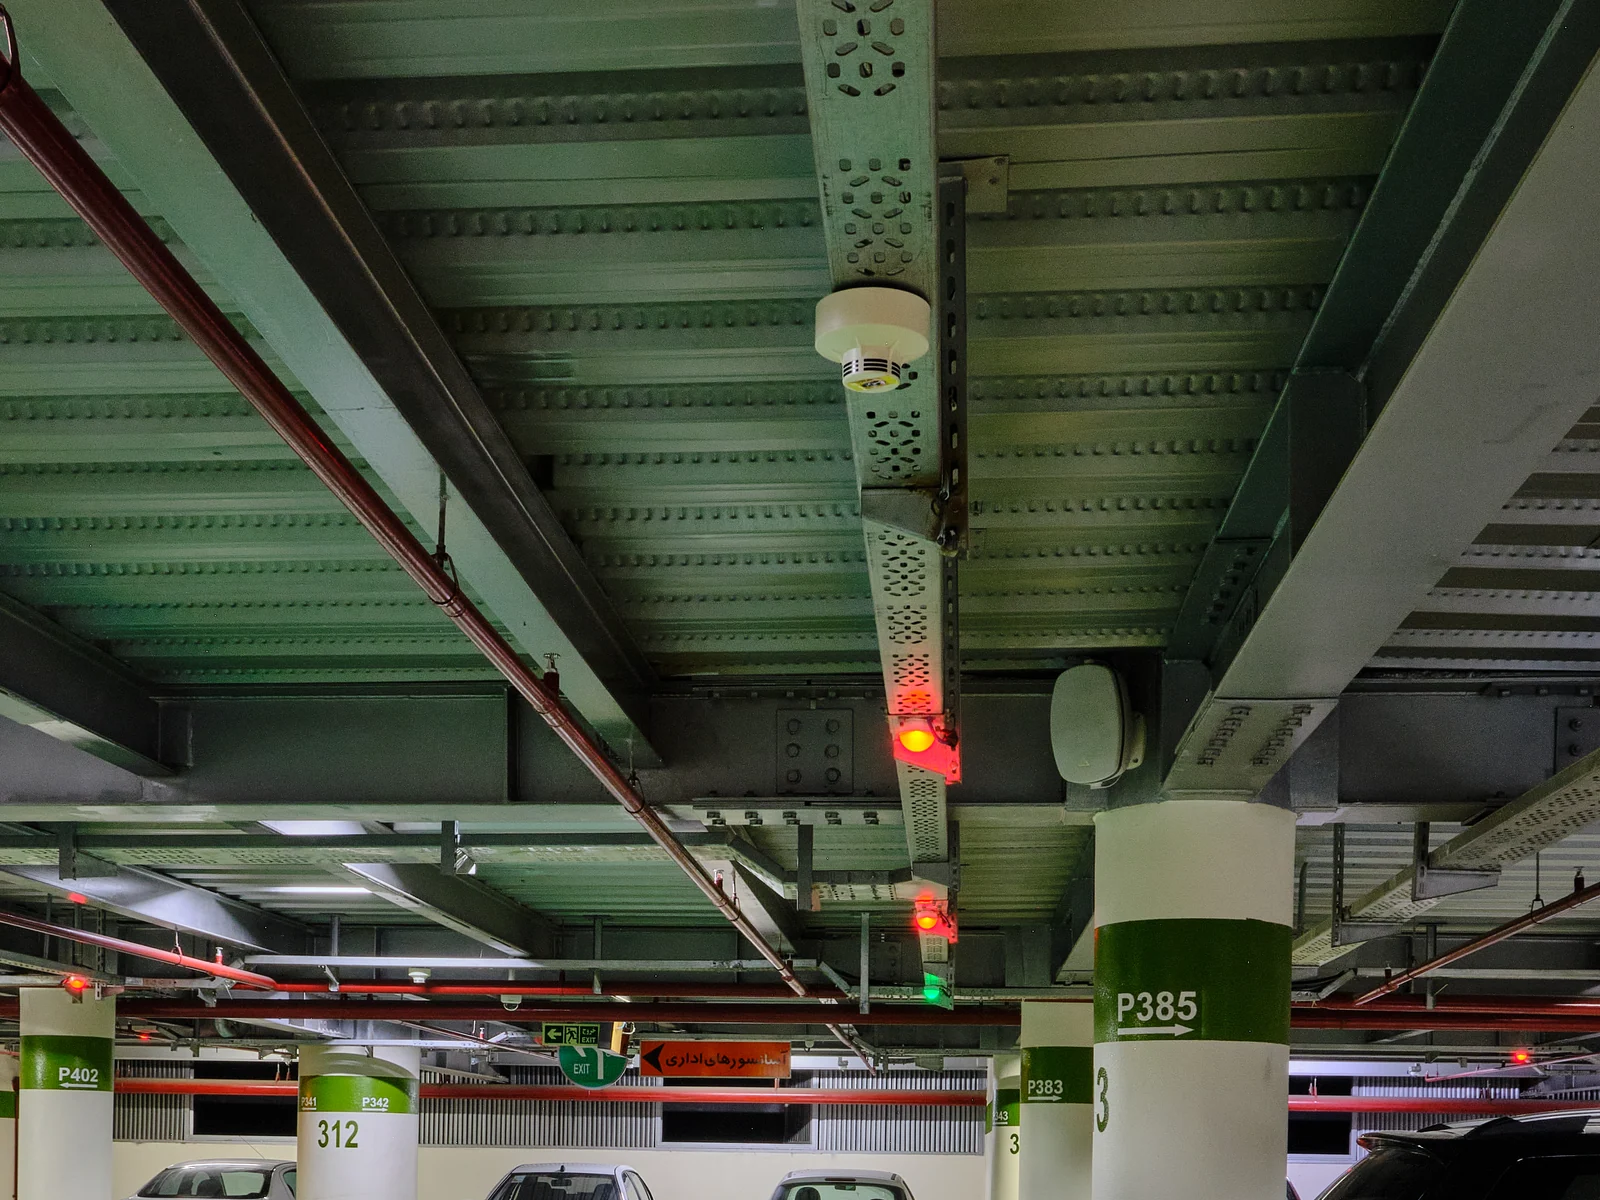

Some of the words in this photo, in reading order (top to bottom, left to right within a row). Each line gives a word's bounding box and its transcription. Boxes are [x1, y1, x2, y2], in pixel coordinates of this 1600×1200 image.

[1118, 991, 1198, 1022] P385
[665, 1053, 703, 1067] اداری
[58, 1067, 99, 1082] P402
[573, 1063, 590, 1075] EXIT
[1027, 1079, 1064, 1095] P383
[362, 1096, 389, 1108] P342
[317, 1119, 359, 1149] 312
